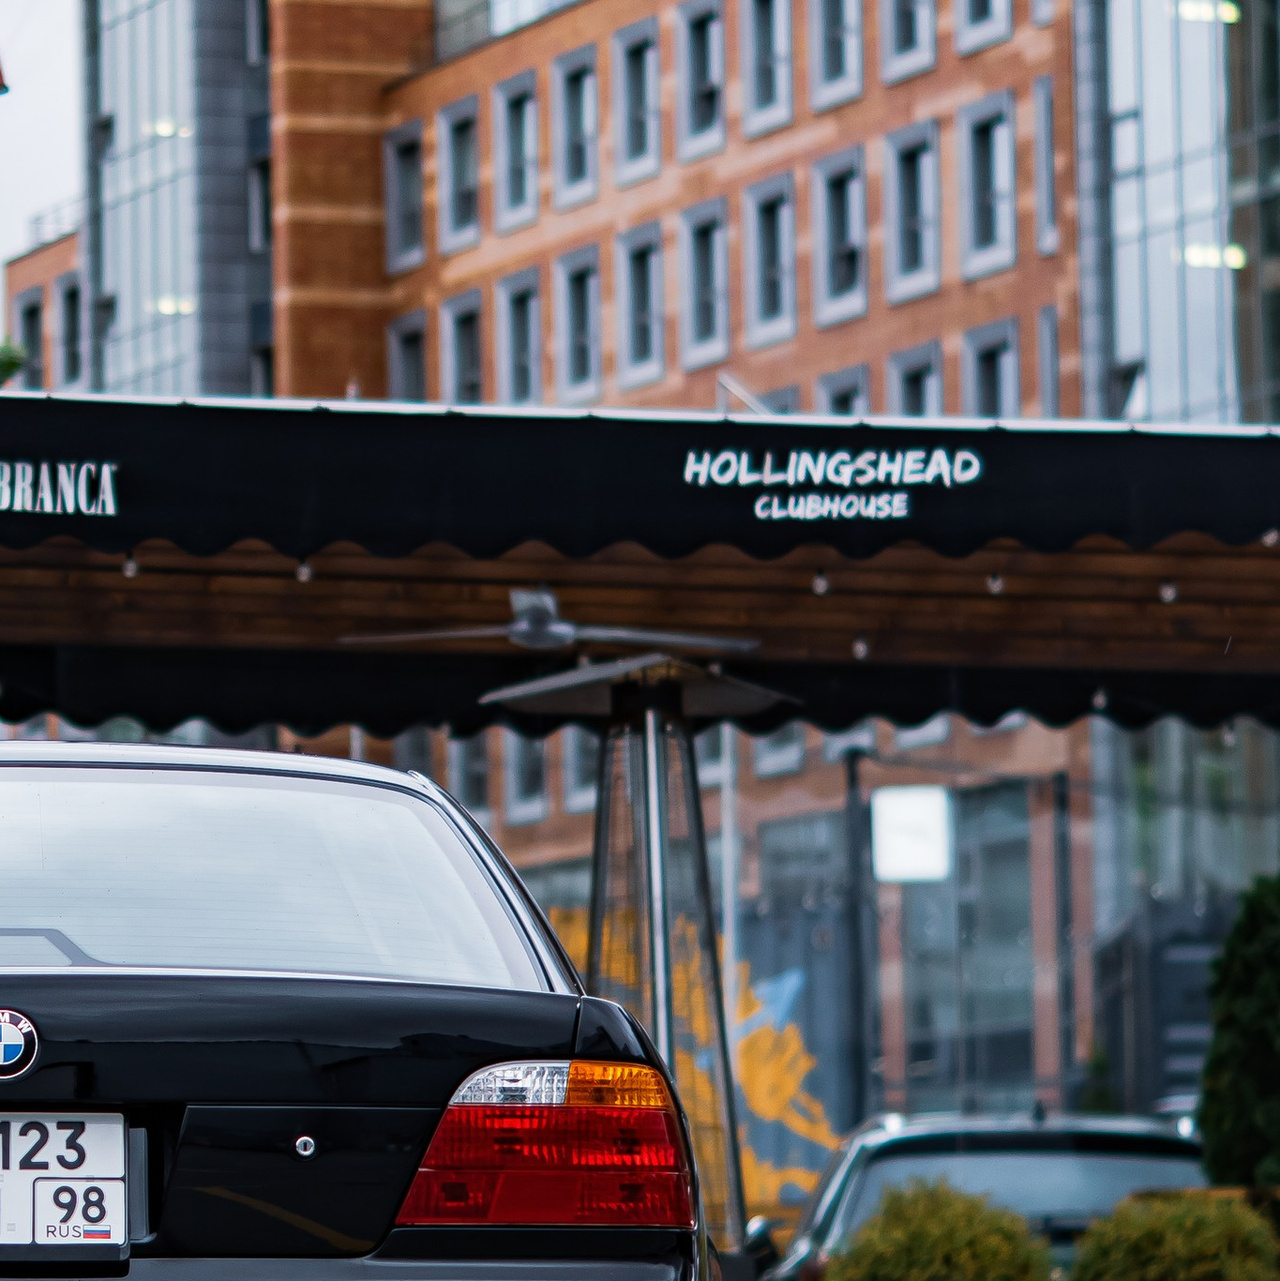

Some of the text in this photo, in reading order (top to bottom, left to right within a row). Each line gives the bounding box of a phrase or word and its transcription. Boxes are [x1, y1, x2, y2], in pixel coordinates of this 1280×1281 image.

[684, 449, 980, 487] HOLLINGSHEAD
[754, 493, 908, 519] CLUBHOUSE
[53, 1185, 106, 1223] 98
[46, 1224, 82, 1238] RUS
